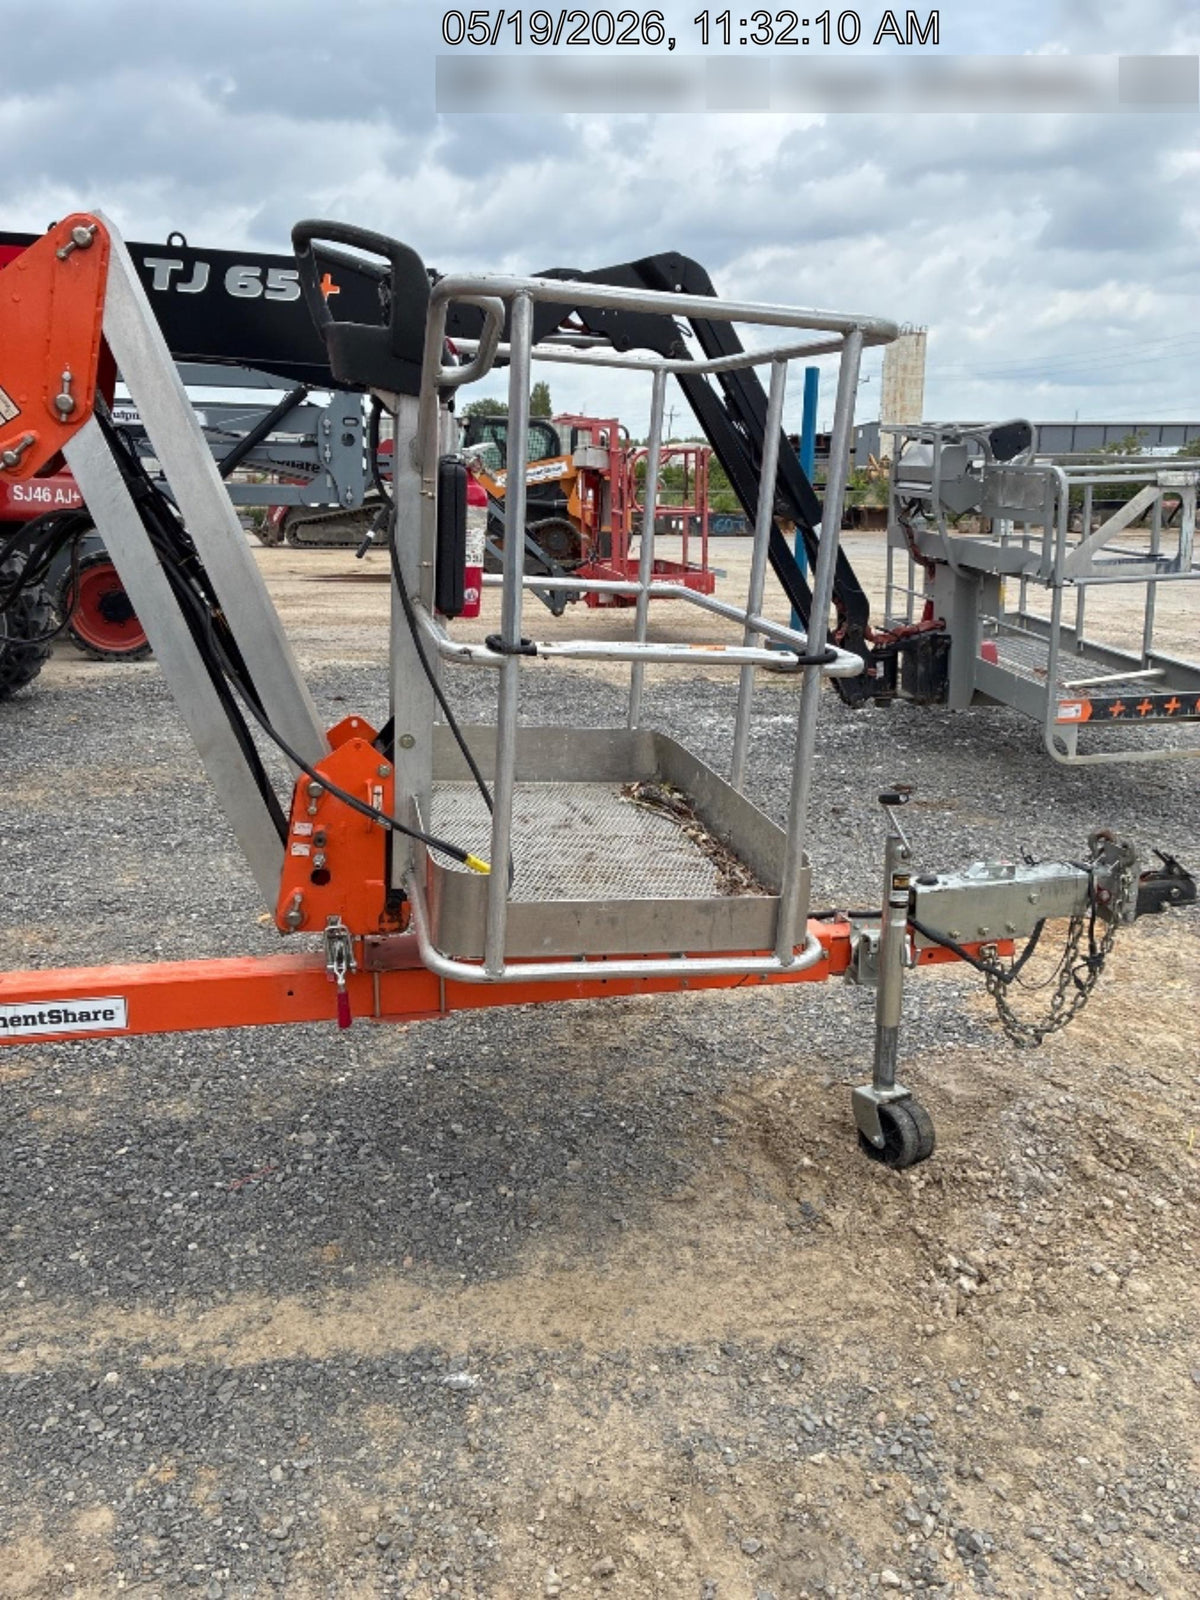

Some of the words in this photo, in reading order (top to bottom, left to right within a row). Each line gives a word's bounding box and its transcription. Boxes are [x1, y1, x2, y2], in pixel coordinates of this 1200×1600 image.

[143, 257, 210, 294] TJ
[13, 484, 52, 502] SJ46
[54, 488, 80, 504] AJ+
